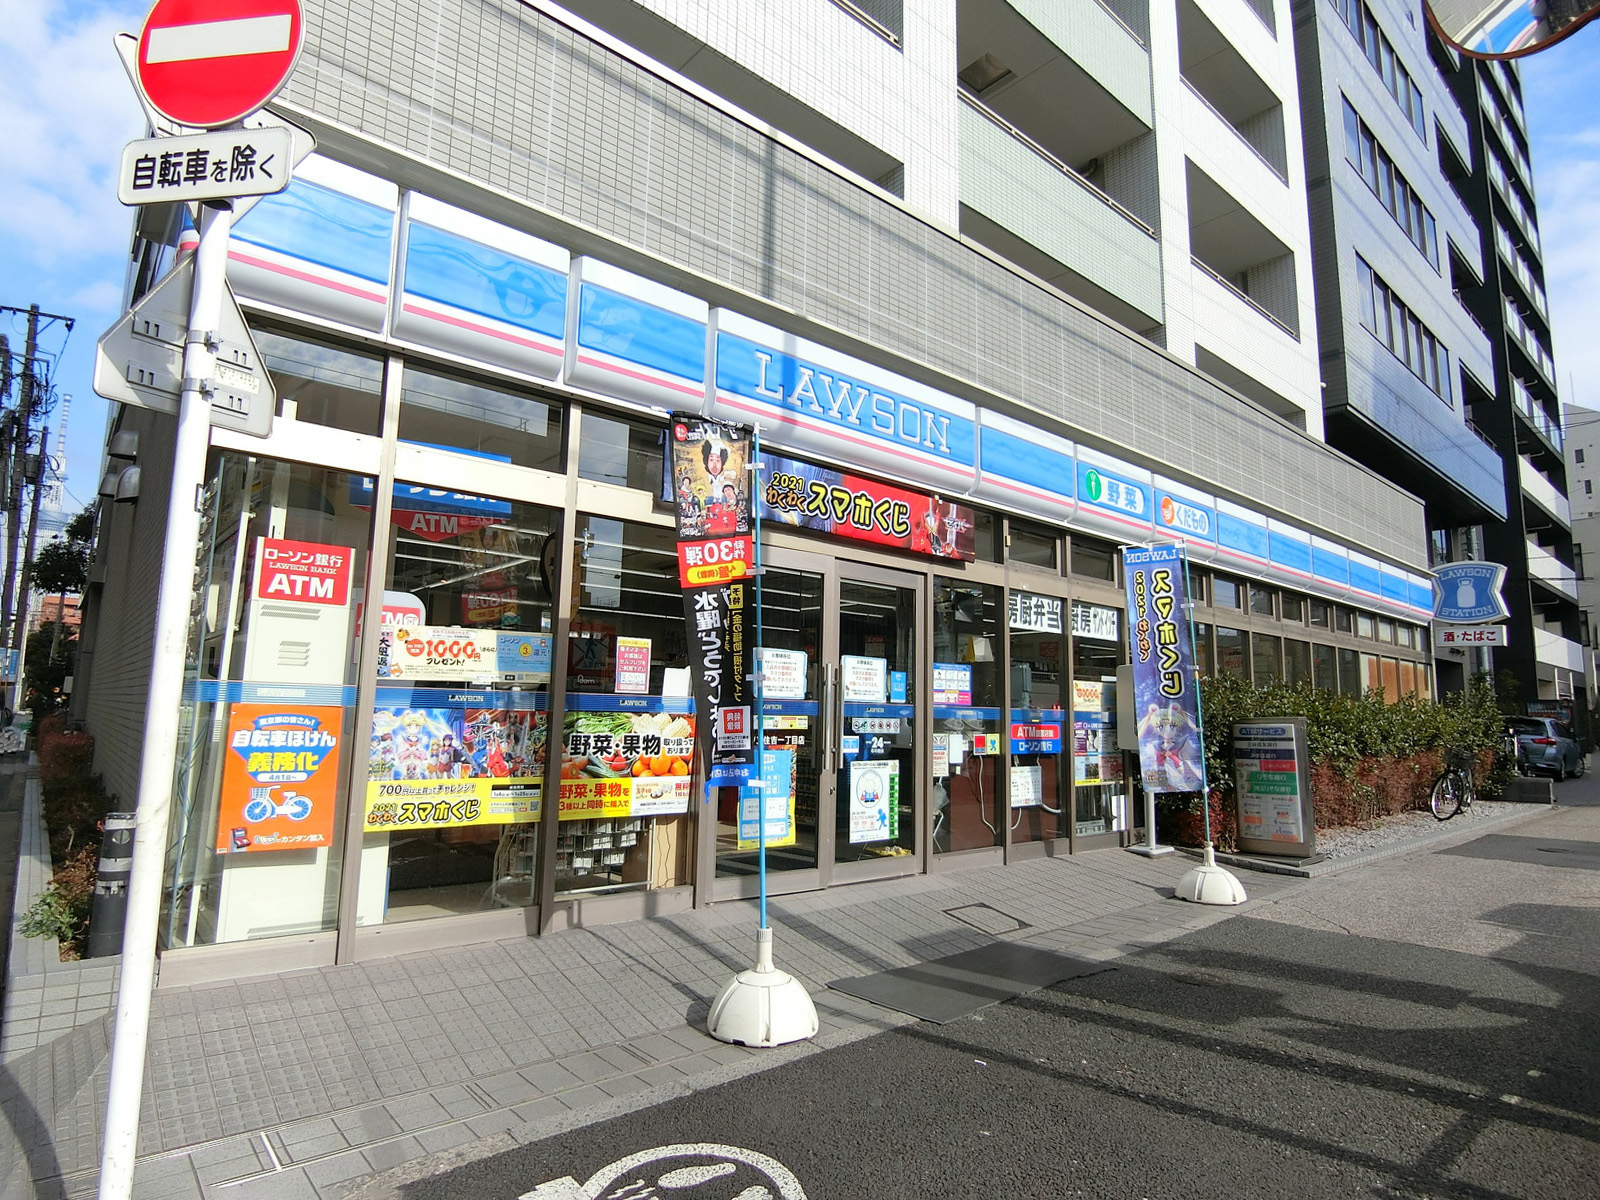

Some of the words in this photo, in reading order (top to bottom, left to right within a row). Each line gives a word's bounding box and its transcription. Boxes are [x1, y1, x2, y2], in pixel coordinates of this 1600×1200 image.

[132, 144, 275, 190] 自転車を除く
[754, 350, 951, 454] LAWSON
[772, 473, 804, 492] 2021
[766, 486, 807, 513] わくわく
[1107, 480, 1138, 511] 野菜
[807, 482, 912, 535] スマホくじ
[410, 513, 458, 534] ATM
[1175, 505, 1208, 533] くだもの
[264, 548, 343, 568] ローソン銀行
[269, 562, 308, 572] LAWSON
[310, 566, 337, 575] BANK
[1440, 568, 1492, 580] LAWSON
[267, 573, 335, 599] ATM
[1441, 605, 1494, 617] STATION
[499, 636, 521, 645] ローソン
[1443, 631, 1497, 642] 酒・たばこ
[448, 694, 485, 702] LAWSON
[231, 730, 337, 748] 自転車ほけん
[1017, 726, 1036, 738] ATM
[569, 734, 662, 757] 野菜・果物
[663, 738, 694, 747] 取り扱って
[667, 747, 690, 755] おります
[871, 736, 884, 749] 24
[1018, 741, 1053, 751] ローソン銀行
[247, 752, 320, 772] 義務化
[559, 782, 630, 799] 野菜・果物を
[372, 802, 398, 812] 2021
[398, 799, 482, 823] スマホくじ
[367, 811, 398, 824] わくわく
